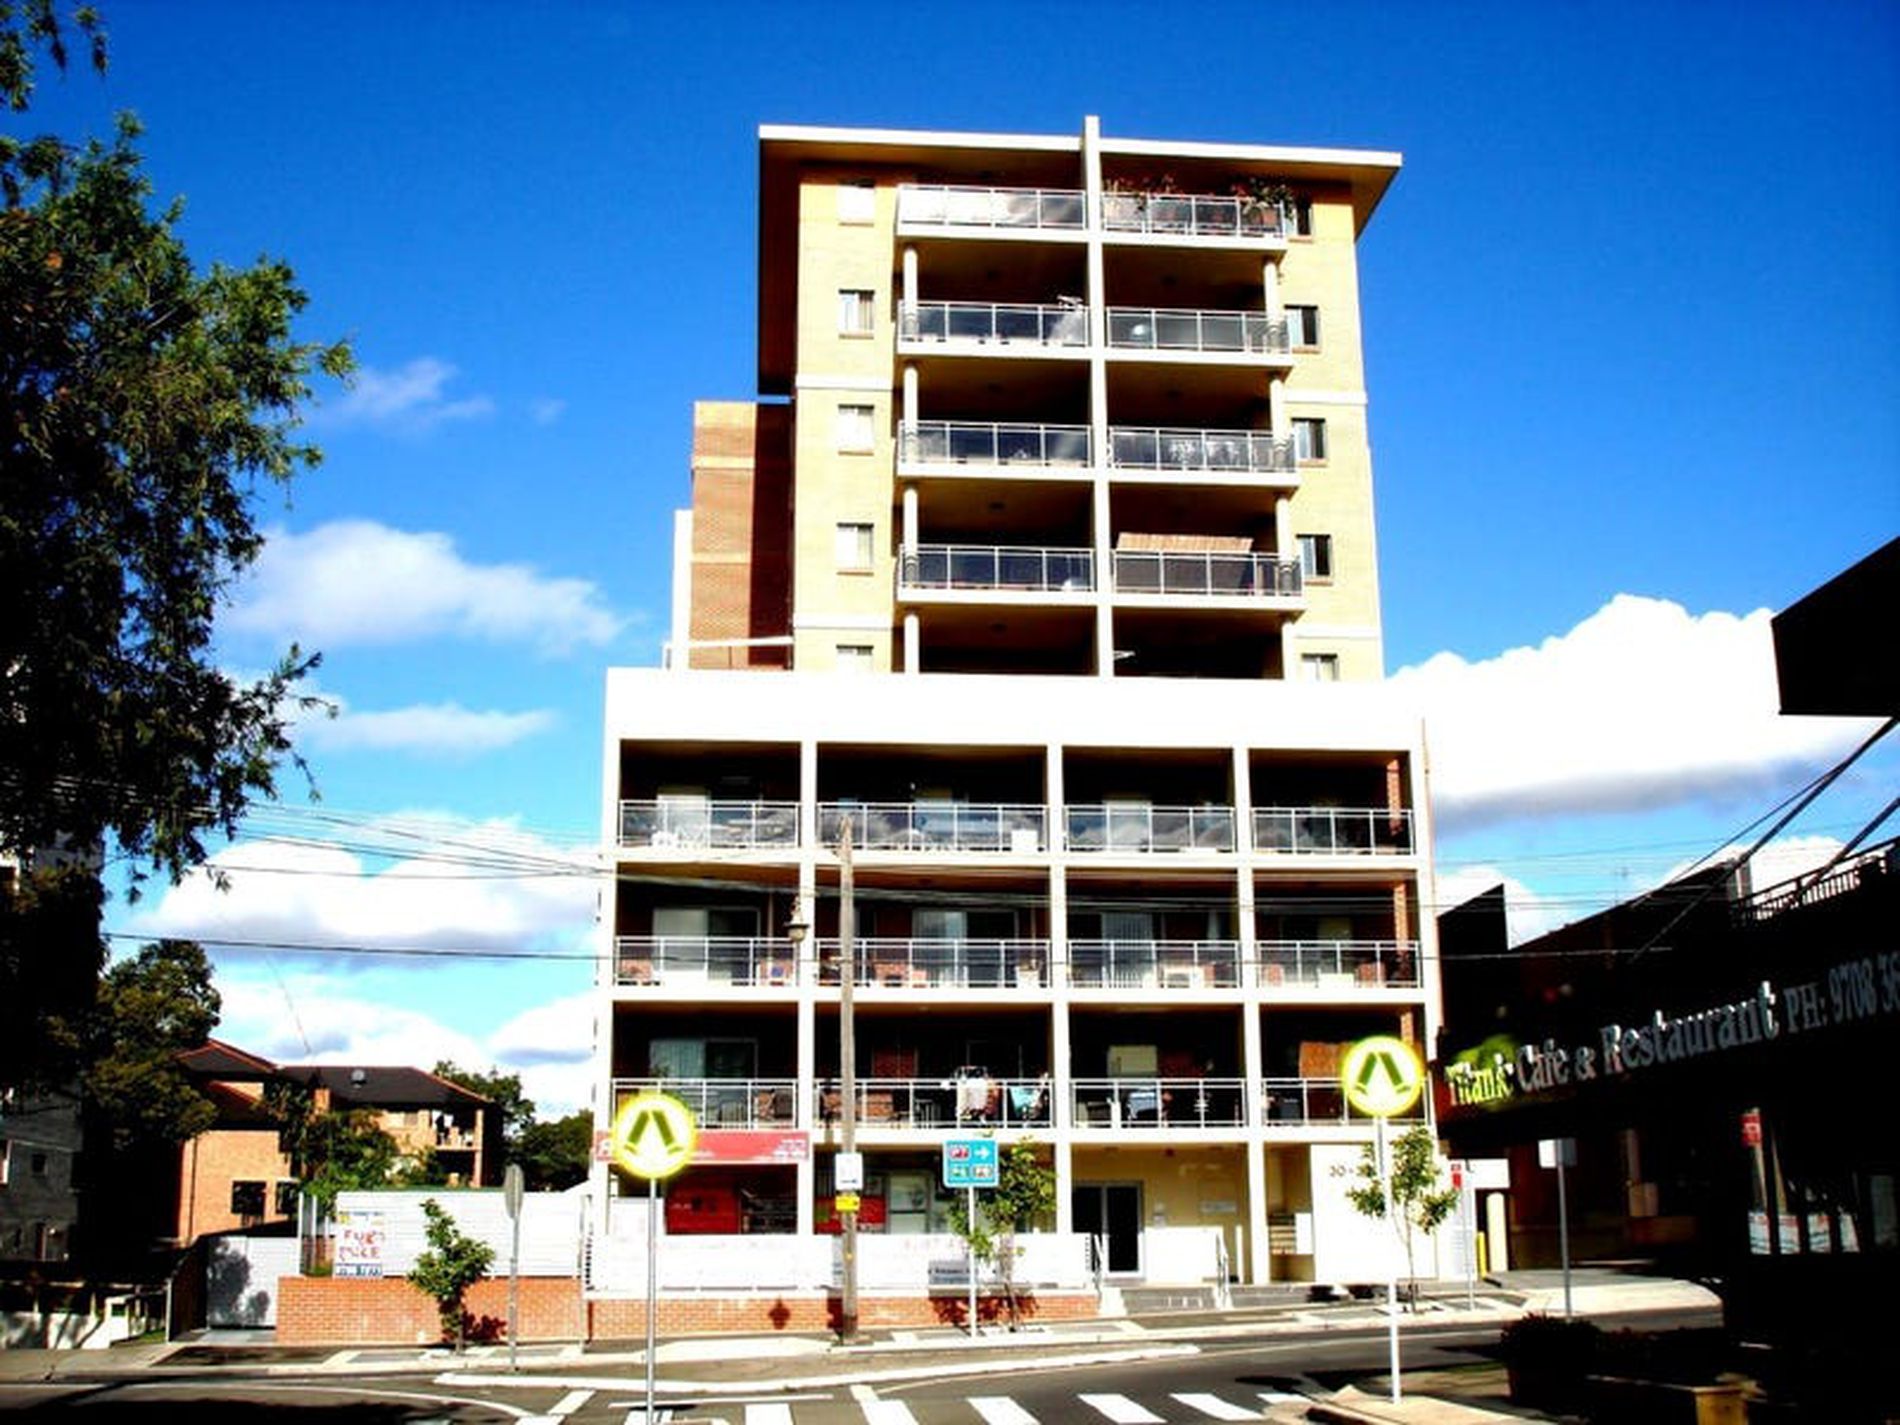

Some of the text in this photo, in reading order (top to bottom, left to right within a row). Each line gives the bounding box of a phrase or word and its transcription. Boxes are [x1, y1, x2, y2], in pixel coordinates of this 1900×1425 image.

[1575, 1046, 1597, 1081] &
[1600, 980, 1780, 1074] Restaurant
[1783, 982, 1828, 1034] PH:
[1828, 957, 1877, 1023] 9708
